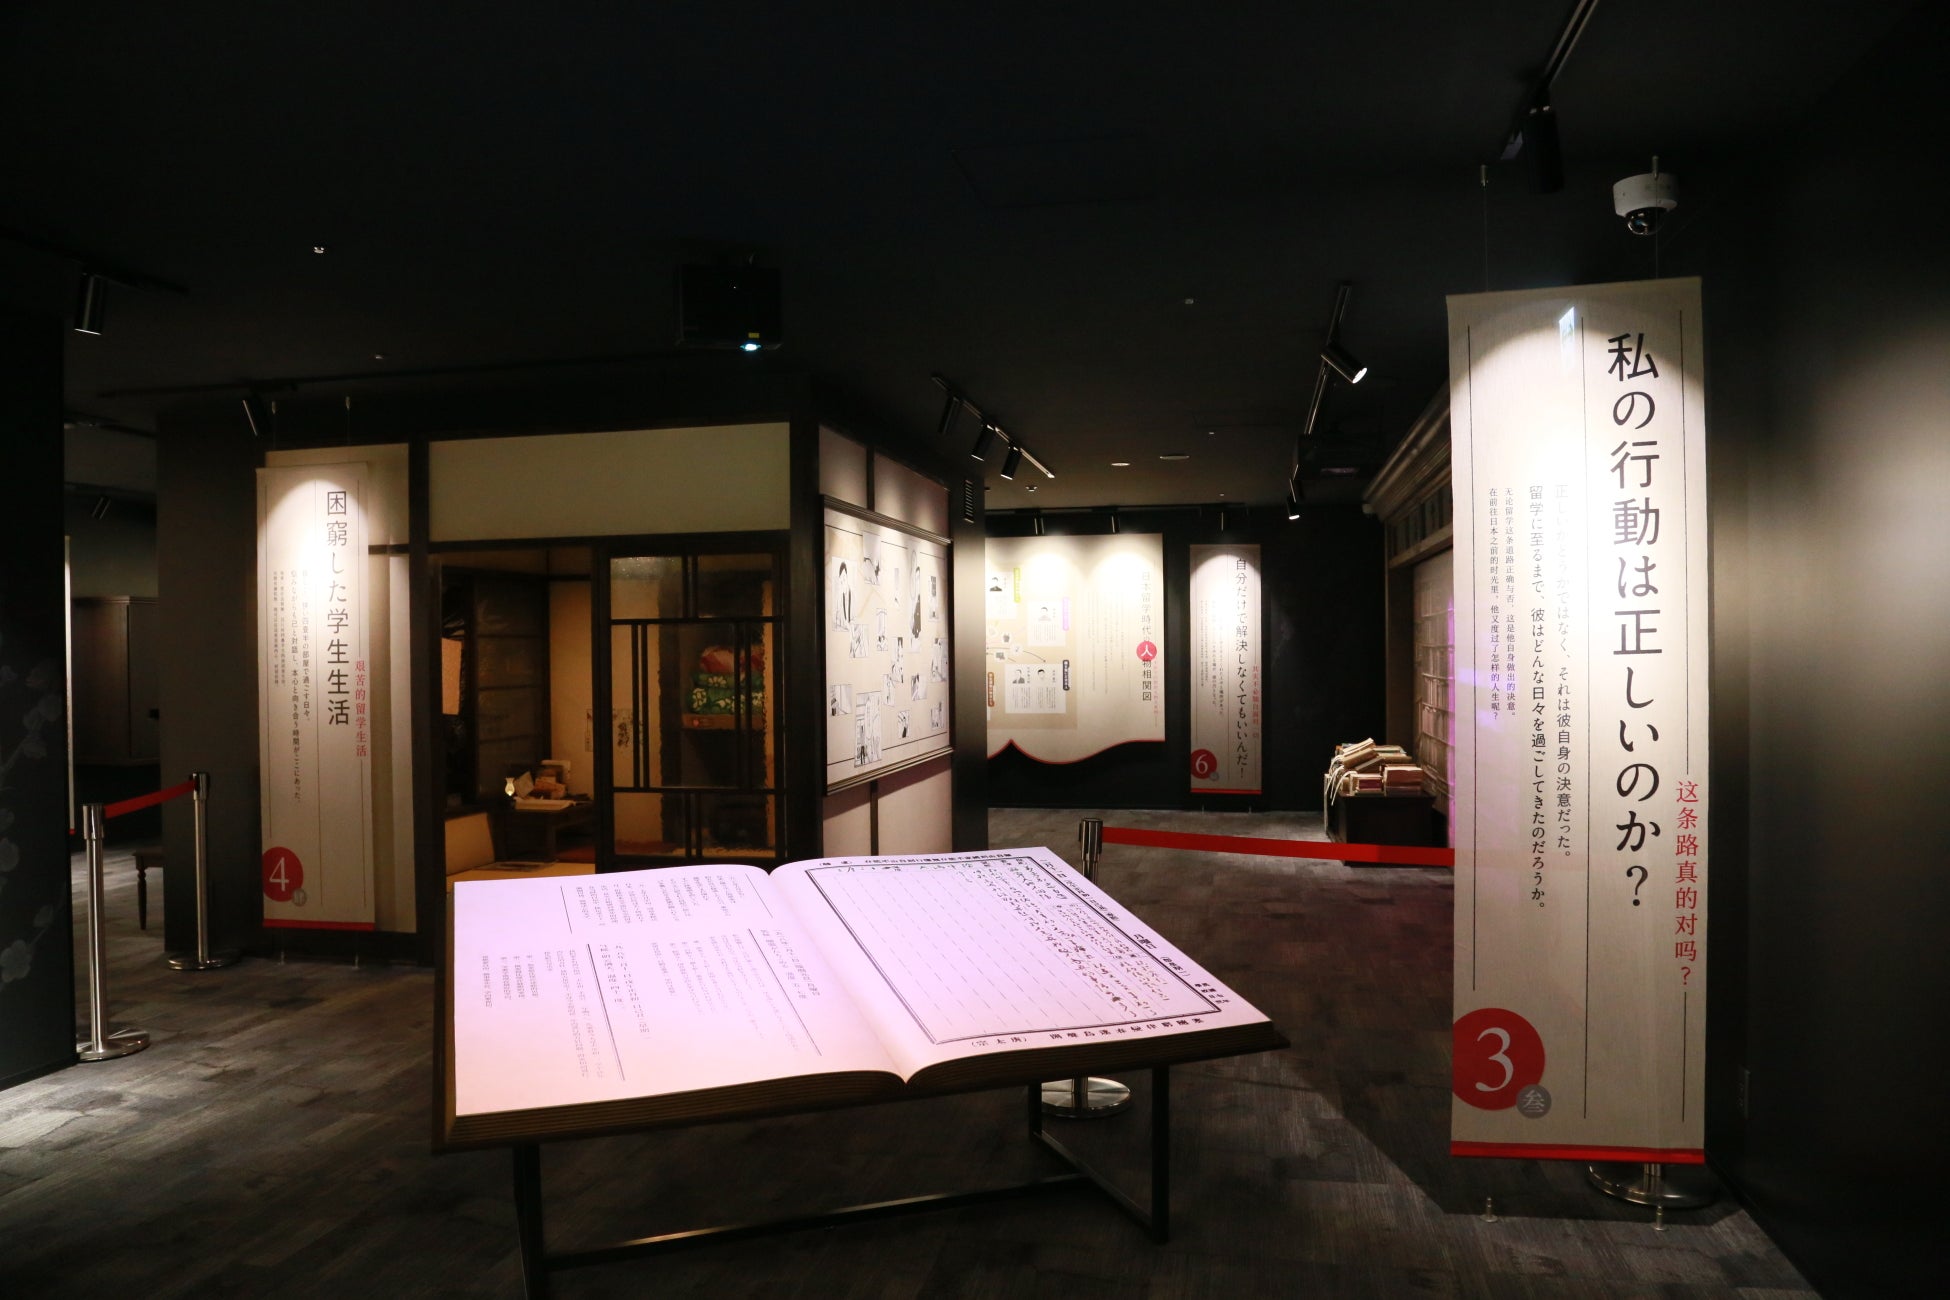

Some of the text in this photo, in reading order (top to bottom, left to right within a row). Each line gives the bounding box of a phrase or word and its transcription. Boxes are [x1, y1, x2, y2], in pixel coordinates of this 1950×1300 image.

[326, 490, 350, 726] 困窮した学生生活
[1529, 485, 1546, 908] 留学に至るまで、彼はどんな日々を過ごしてきたのだろうか。
[1608, 333, 1662, 906] 私の行動は正しいのか？
[1195, 754, 1209, 774] 6
[269, 857, 290, 892] 4
[1674, 780, 1699, 986] 这条路真的对吗？
[1475, 1027, 1513, 1091] 3
